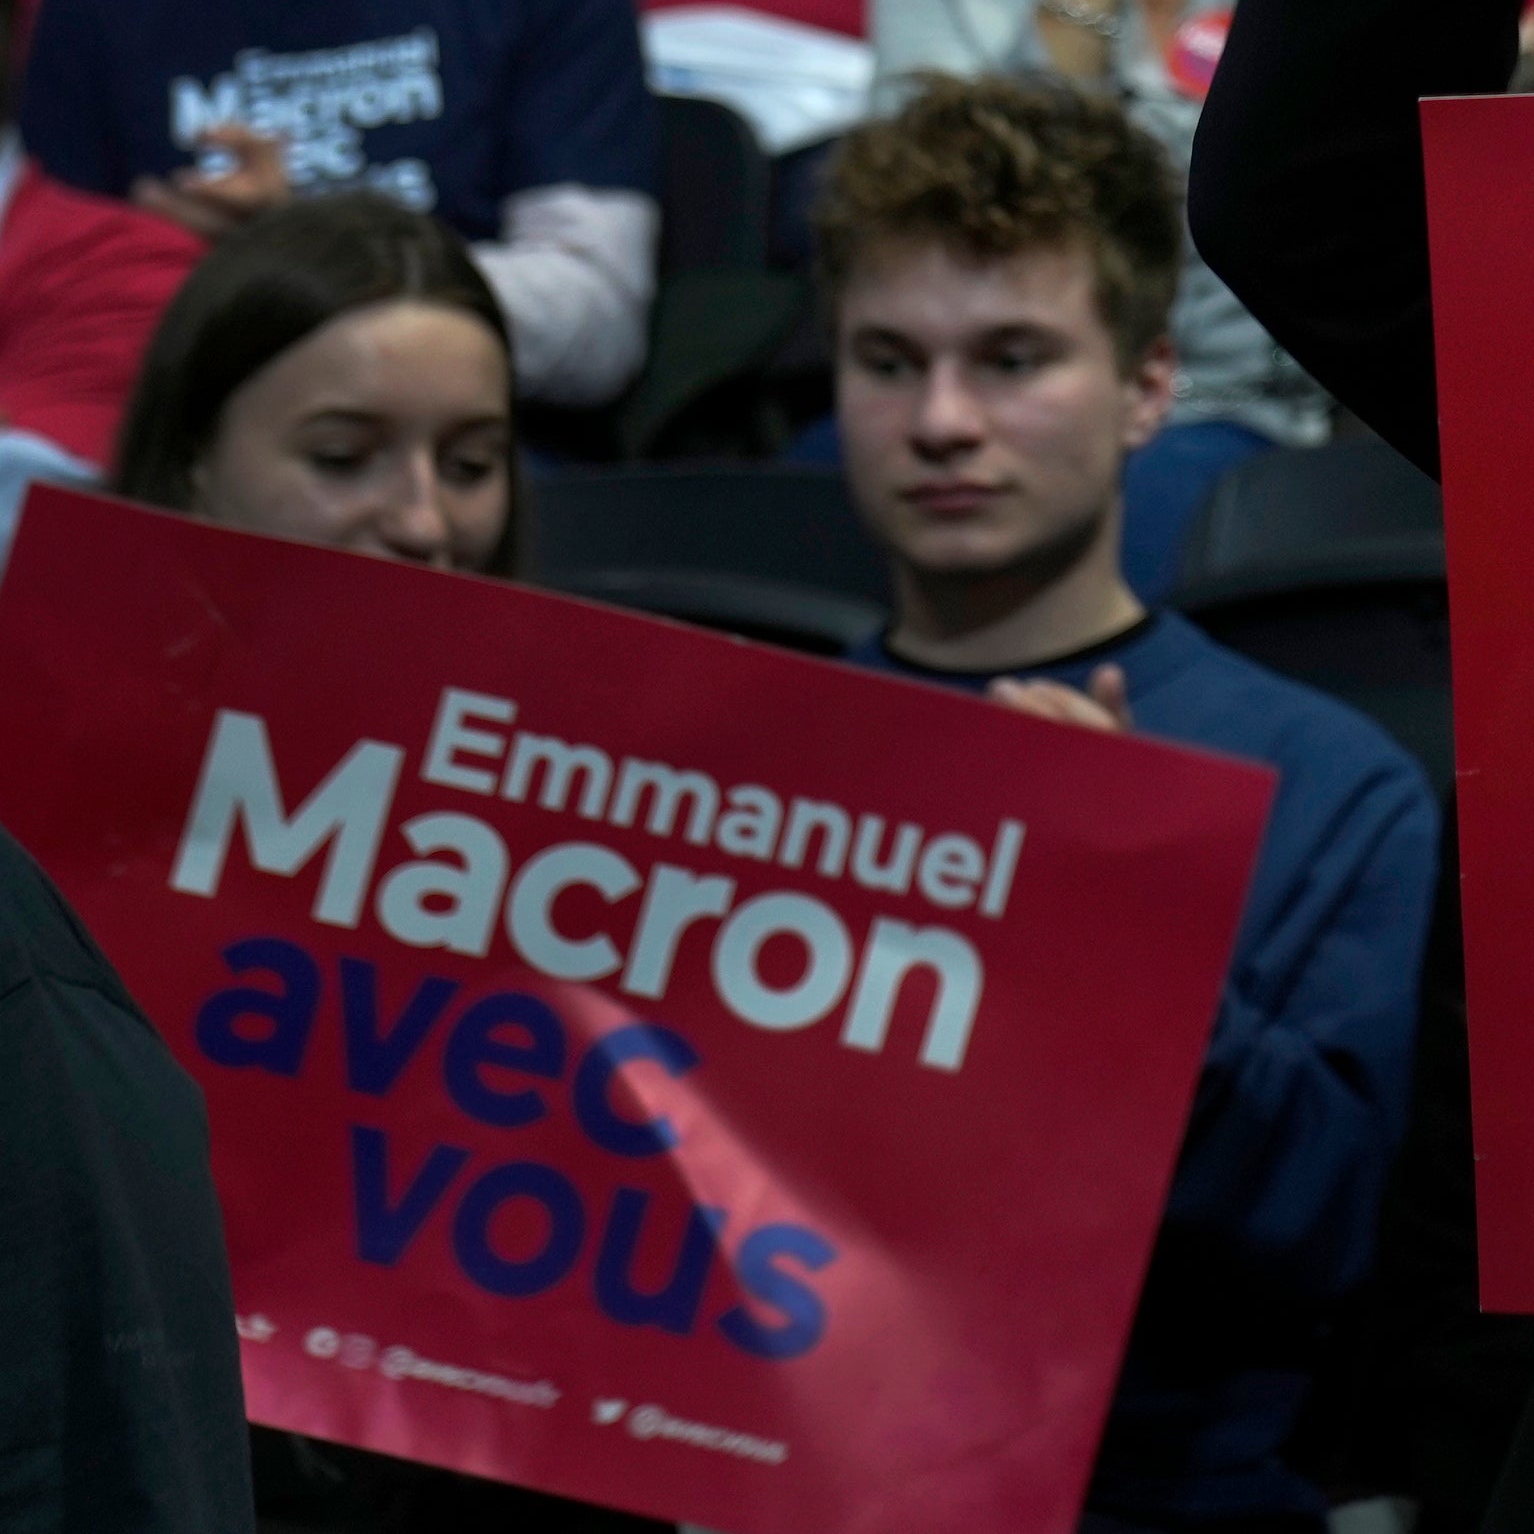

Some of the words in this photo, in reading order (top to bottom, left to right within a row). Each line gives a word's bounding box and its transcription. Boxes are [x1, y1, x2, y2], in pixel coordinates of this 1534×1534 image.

[170, 709, 983, 1072] Macron
[421, 687, 1025, 916] Emmanuel
[195, 936, 701, 1159] avec
[350, 1123, 840, 1362] vous
